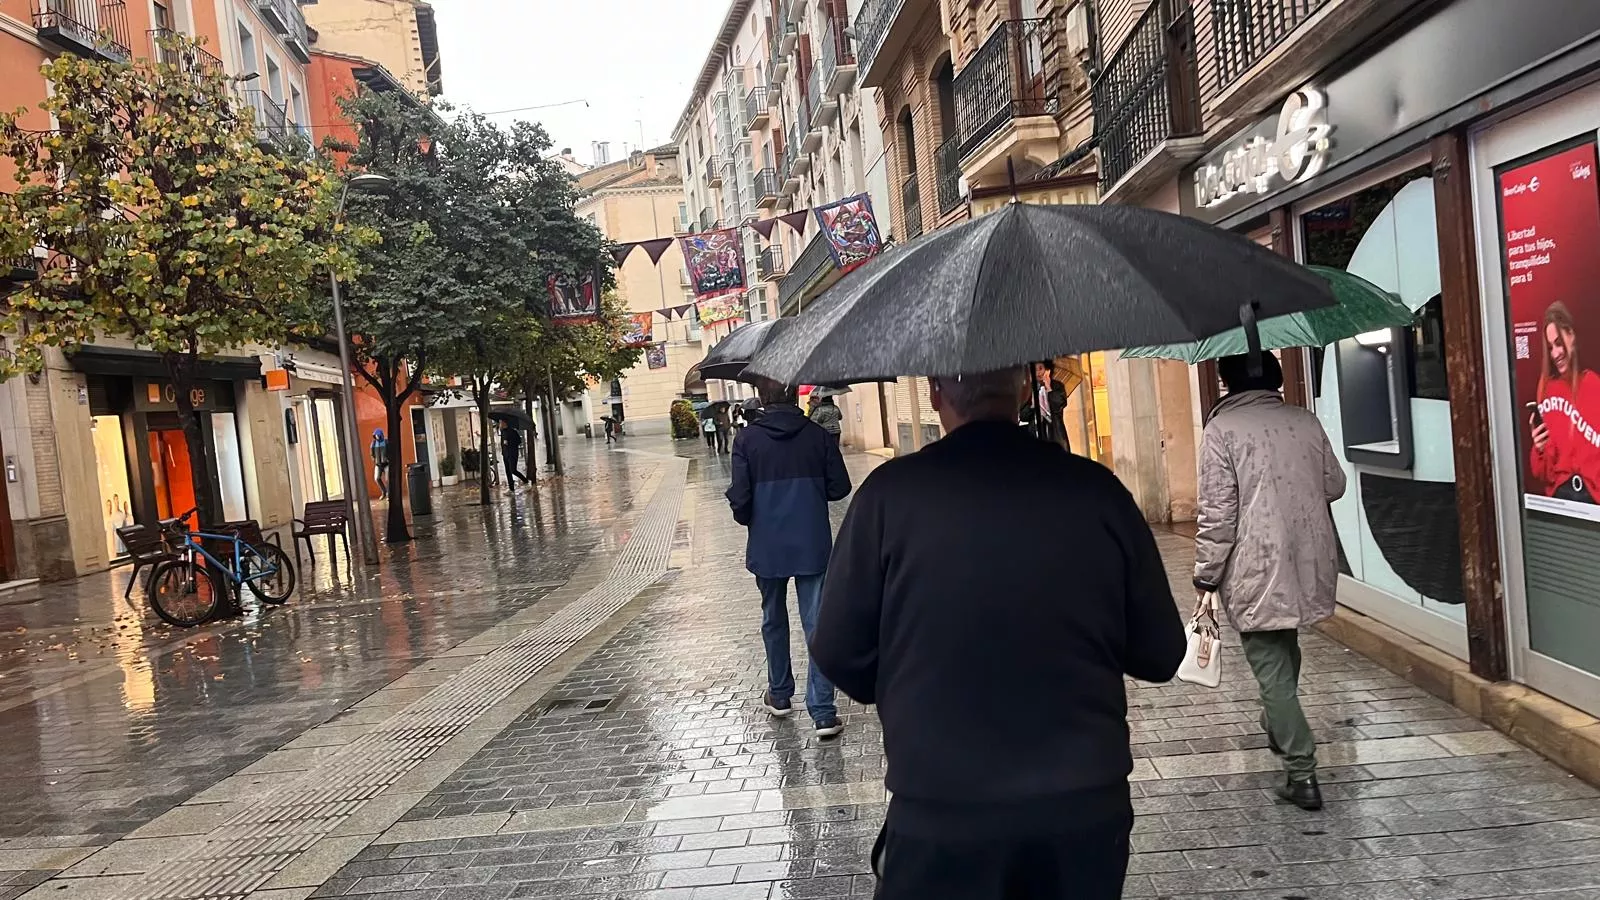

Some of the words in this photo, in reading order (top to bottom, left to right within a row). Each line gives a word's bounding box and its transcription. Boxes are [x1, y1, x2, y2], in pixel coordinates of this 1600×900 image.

[1507, 226, 1536, 241] Libertad
[1509, 246, 1524, 258] para
[1525, 243, 1536, 253] tus
[1536, 238, 1556, 251] hijos,
[1510, 253, 1550, 270] tranquilidad
[1511, 274, 1527, 287] para
[165, 384, 205, 407] Oge
